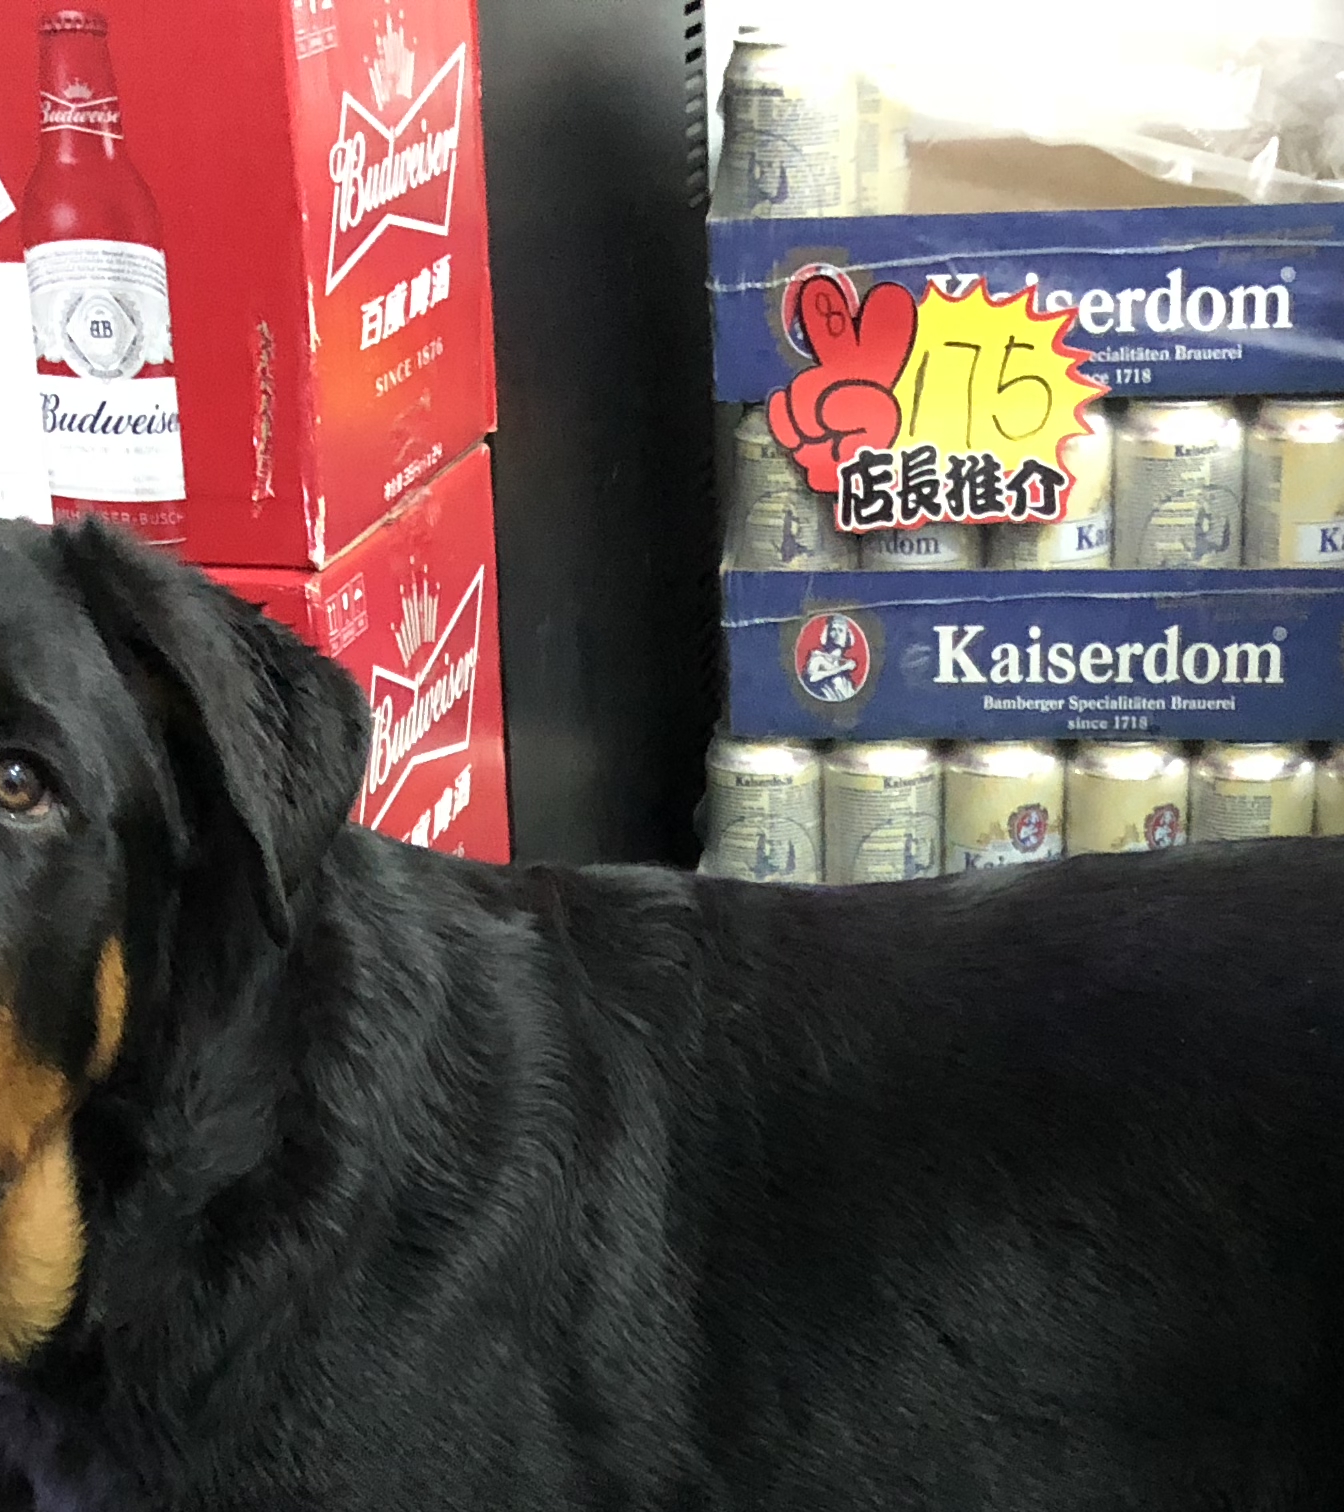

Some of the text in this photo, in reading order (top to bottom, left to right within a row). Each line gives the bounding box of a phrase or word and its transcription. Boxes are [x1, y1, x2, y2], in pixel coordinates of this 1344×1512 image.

[329, 118, 460, 233] Budweiser
[1114, 368, 1152, 385] 1718
[1174, 344, 1243, 362] Brauerei
[375, 359, 412, 398] SINCE
[909, 335, 1053, 450] 175
[839, 445, 1066, 529] 店長推介
[933, 624, 1285, 684] Kaiserdom
[368, 646, 478, 795] Budweiser
[983, 694, 1237, 712] Bamberger Specialitäten Brauerei
[1067, 716, 1150, 731] since 1718
